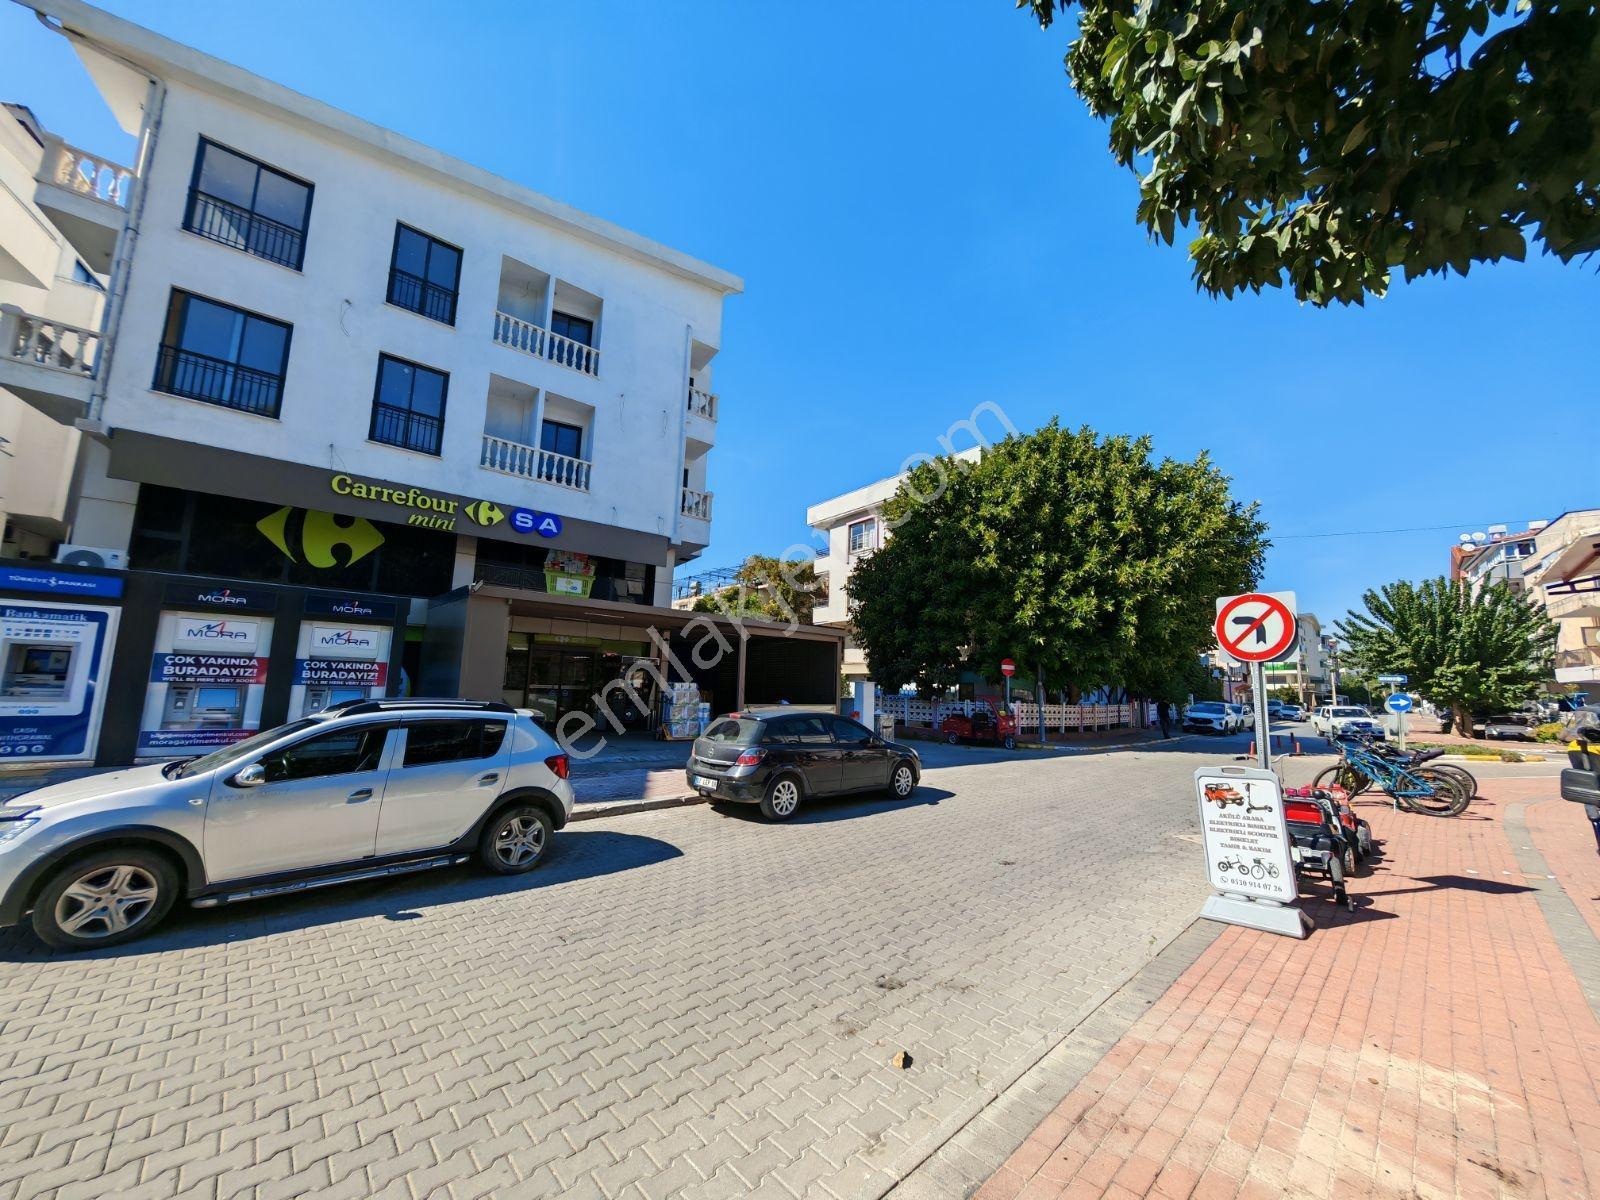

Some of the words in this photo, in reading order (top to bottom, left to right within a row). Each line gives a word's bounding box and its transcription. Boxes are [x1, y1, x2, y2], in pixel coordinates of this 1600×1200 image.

[331, 475, 458, 514] Carrefour
[515, 512, 558, 533] SA
[408, 514, 456, 531] mini
[198, 594, 247, 604] MORA
[332, 605, 372, 614] MORA
[5, 609, 88, 621] Bankamatik
[187, 629, 247, 639] MORA
[321, 636, 370, 646] MORA
[164, 655, 196, 665] ÇOK
[199, 656, 259, 666] YAKINDA
[303, 661, 328, 670] ÇOK
[331, 662, 379, 670] YAKINDA
[162, 666, 257, 677] BURADAYIZ!
[302, 670, 378, 680] BURADAYIZ!
